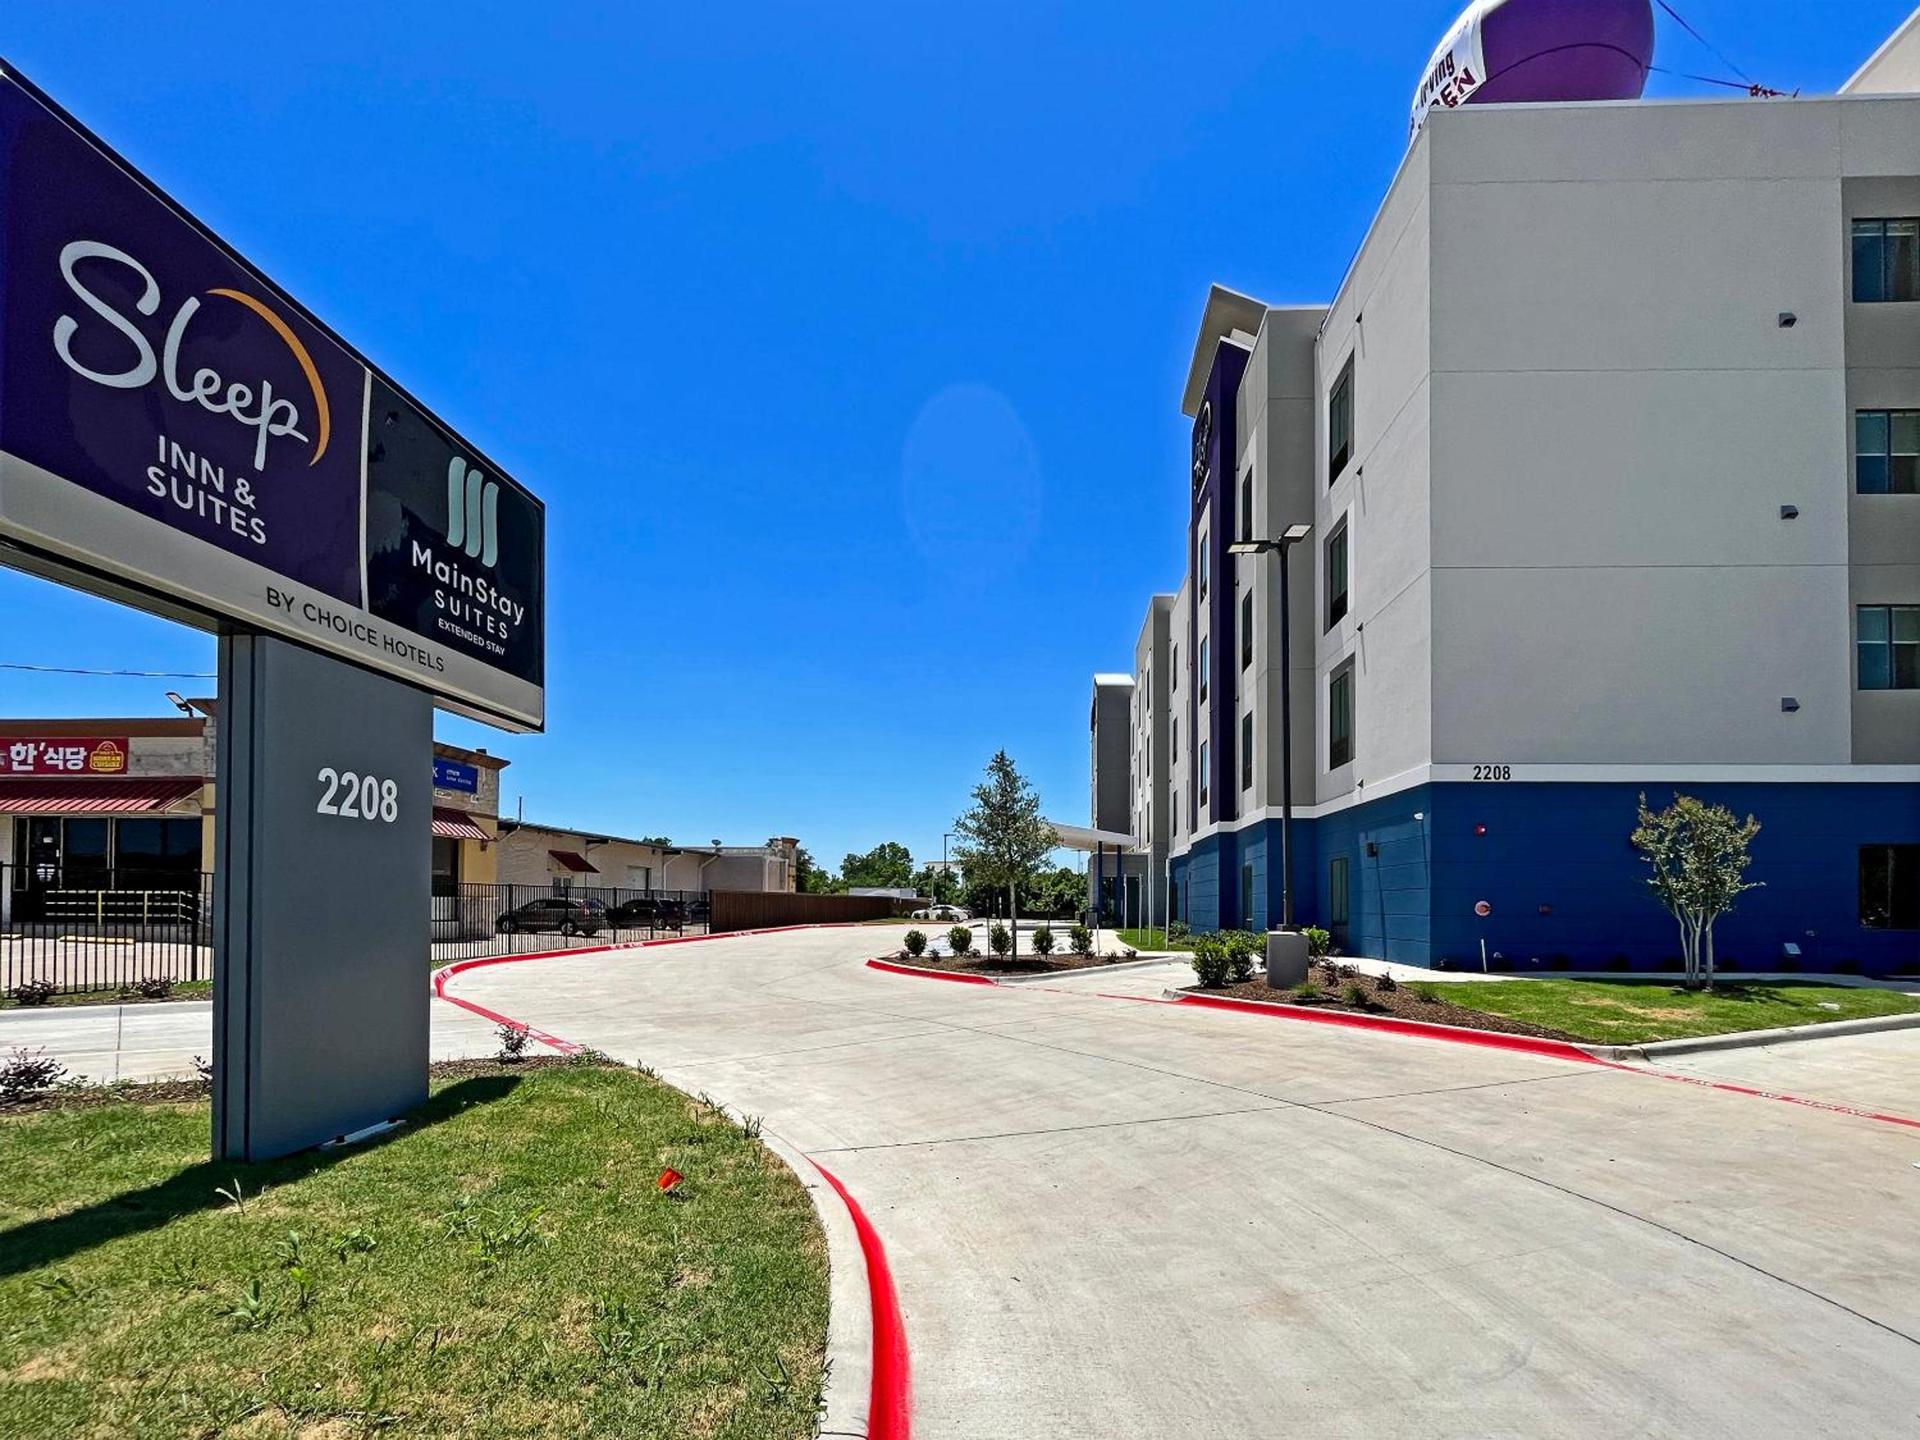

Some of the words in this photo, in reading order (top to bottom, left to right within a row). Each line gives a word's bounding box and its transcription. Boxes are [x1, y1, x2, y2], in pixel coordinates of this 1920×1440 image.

[1421, 50, 1455, 107] Irving
[54, 240, 308, 471] Sleep
[158, 435, 224, 493] INN
[233, 478, 257, 510] &
[147, 467, 266, 545] SUITES
[412, 540, 524, 625] MainStay
[435, 590, 508, 639] SUITES
[266, 587, 294, 612] BY
[303, 603, 377, 646] CHOICE
[383, 637, 444, 672] HOTELS
[438, 618, 484, 648] EXTENDED
[486, 641, 505, 656] STAY
[317, 767, 397, 823] 2208
[1473, 766, 1511, 780] 2208
